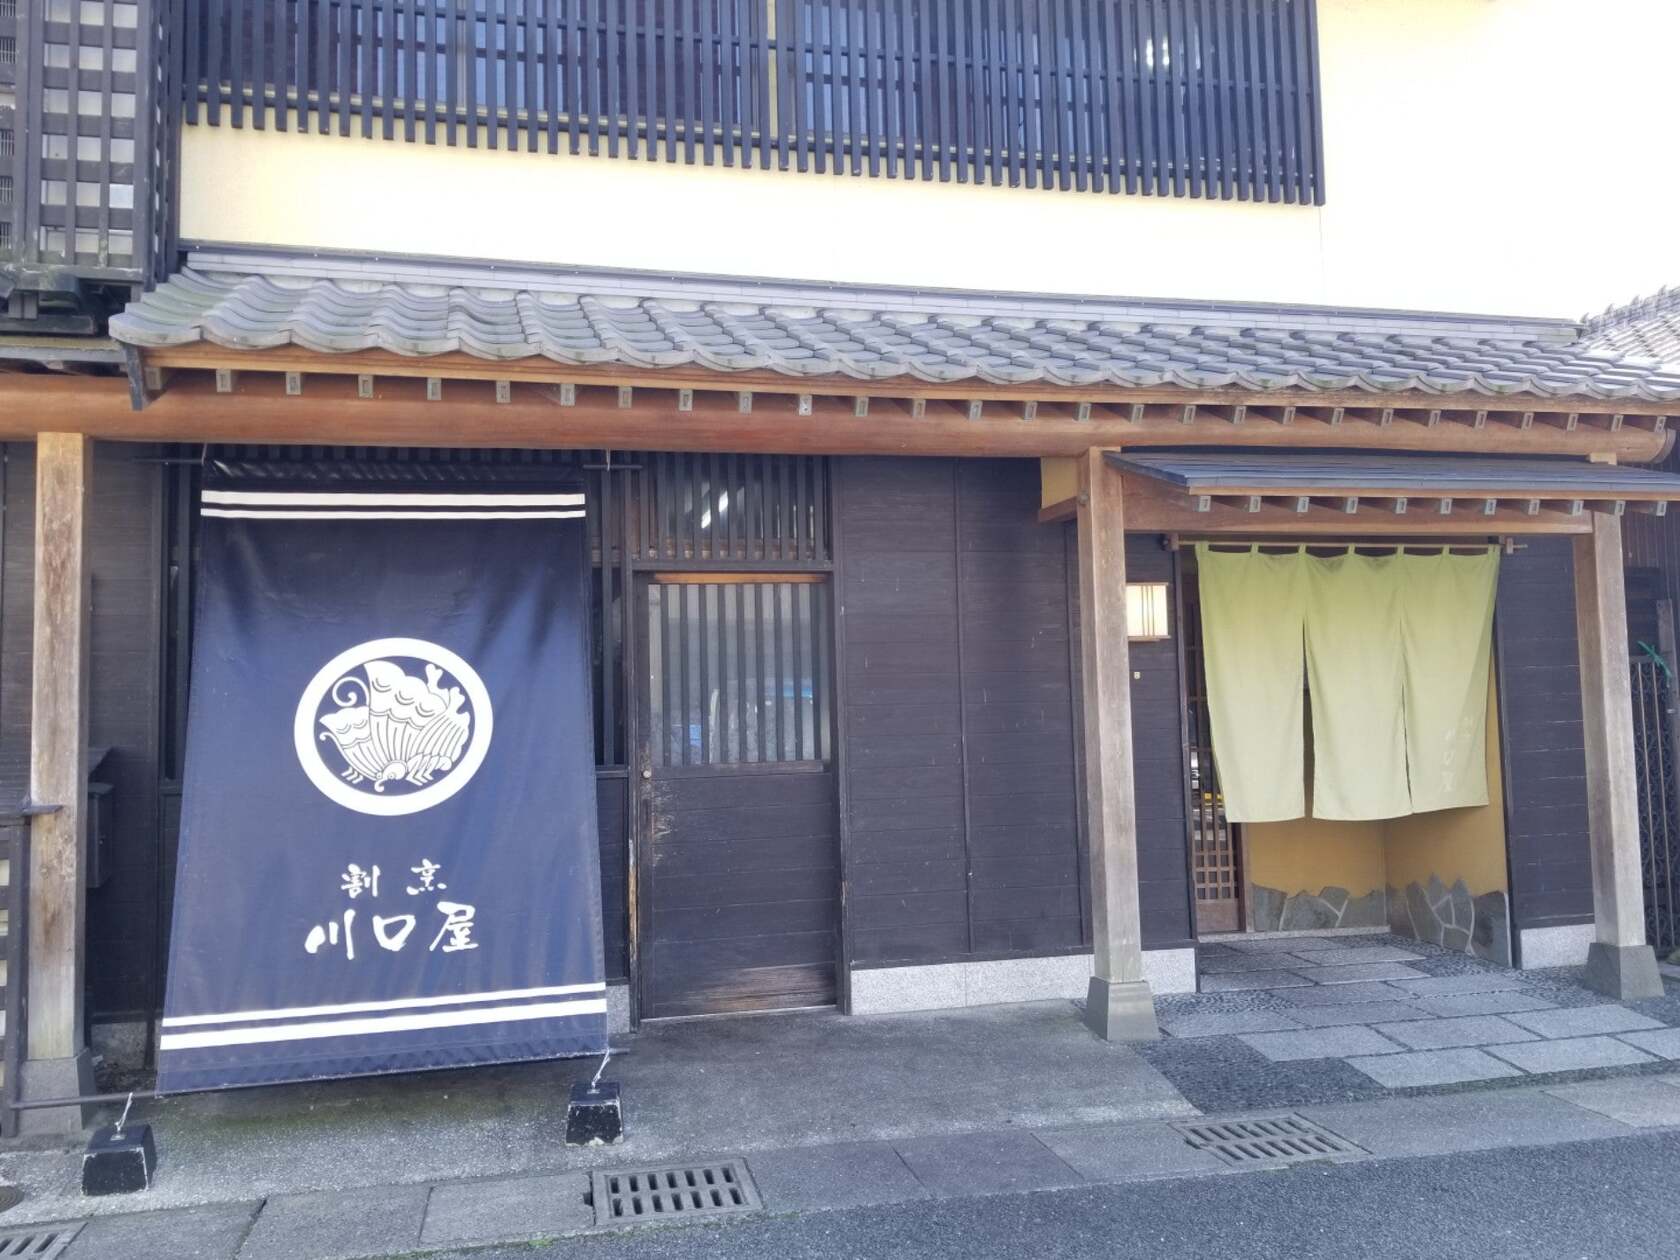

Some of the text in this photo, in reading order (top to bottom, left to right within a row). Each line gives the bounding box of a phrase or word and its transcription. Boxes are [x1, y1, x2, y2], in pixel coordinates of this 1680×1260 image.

[340, 858, 448, 899] 割烹
[304, 901, 479, 961] 川口屋
